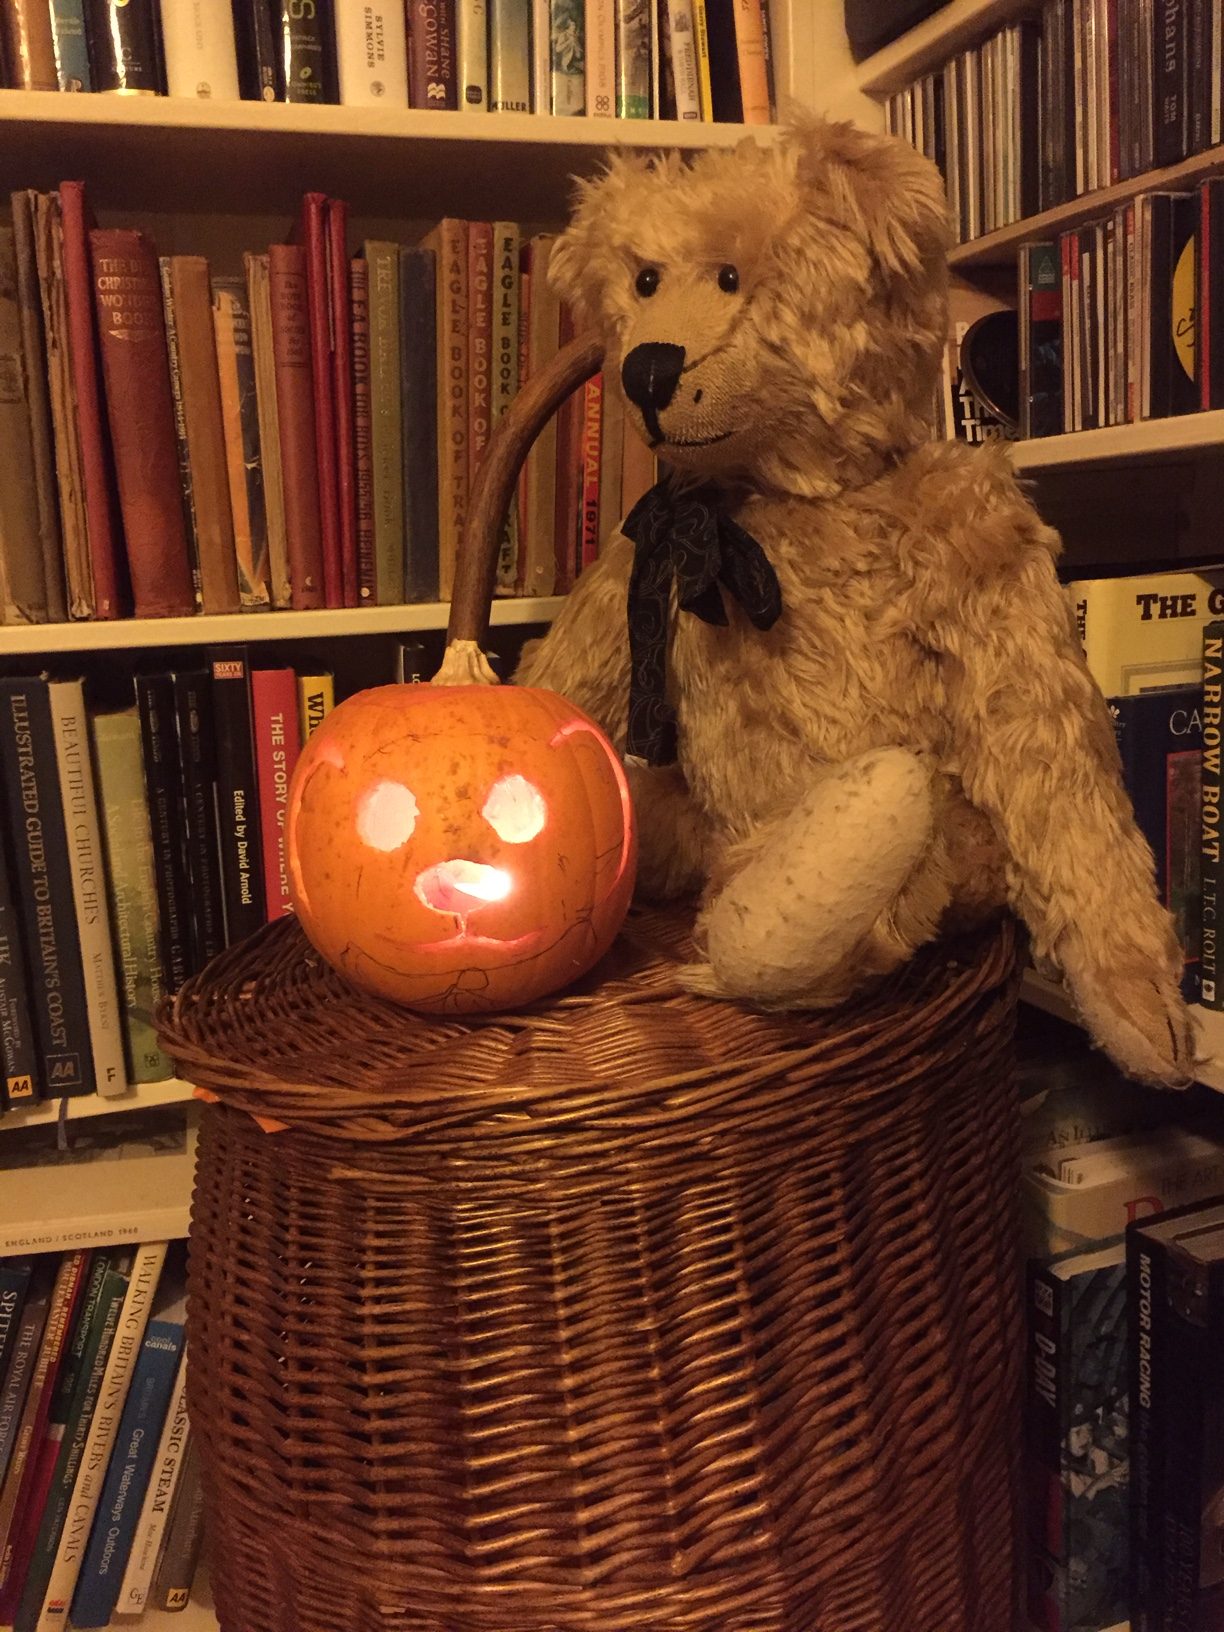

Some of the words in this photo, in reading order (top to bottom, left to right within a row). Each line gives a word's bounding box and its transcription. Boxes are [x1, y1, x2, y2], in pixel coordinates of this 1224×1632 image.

[364, 6, 376, 69] SIMMONS
[374, 14, 385, 63] SYLVIE
[449, 239, 465, 334] EAGLE
[474, 237, 488, 327] EAGLE
[501, 237, 515, 327] EAGLE
[450, 347, 464, 417] BOOK
[474, 338, 488, 408] BOOK
[501, 336, 512, 396] BOOK
[452, 431, 465, 464] OF
[474, 418, 487, 450] OF
[585, 383, 601, 488] ANNUAL
[585, 499, 598, 545] 1971
[214, 663, 242, 673] SIXTY
[270, 713, 284, 745] THE
[1203, 638, 1222, 776] NARROW
[11, 693, 39, 814] ILLUSTRATED
[272, 750, 287, 803] STORY
[61, 715, 87, 815] BEAUTIFUL
[75, 823, 99, 925] CHURCHES
[233, 789, 245, 822] Edited
[1202, 785, 1220, 862] BOAT
[25, 816, 47, 873] GUIDE
[236, 824, 246, 838] by
[237, 840, 249, 870] David
[33, 875, 50, 899] TO
[239, 870, 252, 905] Arnold
[281, 902, 294, 916] Y
[36, 901, 61, 988] BRITAIN'S
[116, 881, 138, 961] Architectural
[171, 944, 184, 990] GARD
[1203, 927, 1217, 975] ROLT
[122, 961, 138, 1009] History
[151, 967, 163, 1004] House
[46, 990, 67, 1048] COAST
[11, 1079, 30, 1093] AA
[51, 1060, 75, 1078] AA
[5, 1235, 52, 1249] ENGLAND
[62, 1228, 114, 1243] SCOTLAND
[86, 1256, 106, 1301] LONDON
[125, 1254, 158, 1330] WALKING
[1138, 1252, 1151, 1328] MOTOR
[23, 1323, 36, 1348] THE
[71, 1300, 93, 1359] TRANSPORT
[145, 1340, 177, 1353] canals
[12, 1349, 30, 1392] ROYAL
[1138, 1331, 1151, 1408] RACING
[6, 1391, 18, 1416] AIR
[0, 1416, 12, 1451] FORC
[87, 1414, 114, 1472] RIVERS
[128, 1428, 145, 1459] Great
[80, 1474, 94, 1500] and
[112, 1463, 137, 1522] Waterways
[151, 1456, 177, 1514] STEAM
[63, 1502, 91, 1564] CANALS
[98, 1527, 121, 1575] Outdoors
[169, 1591, 186, 1602] AA
